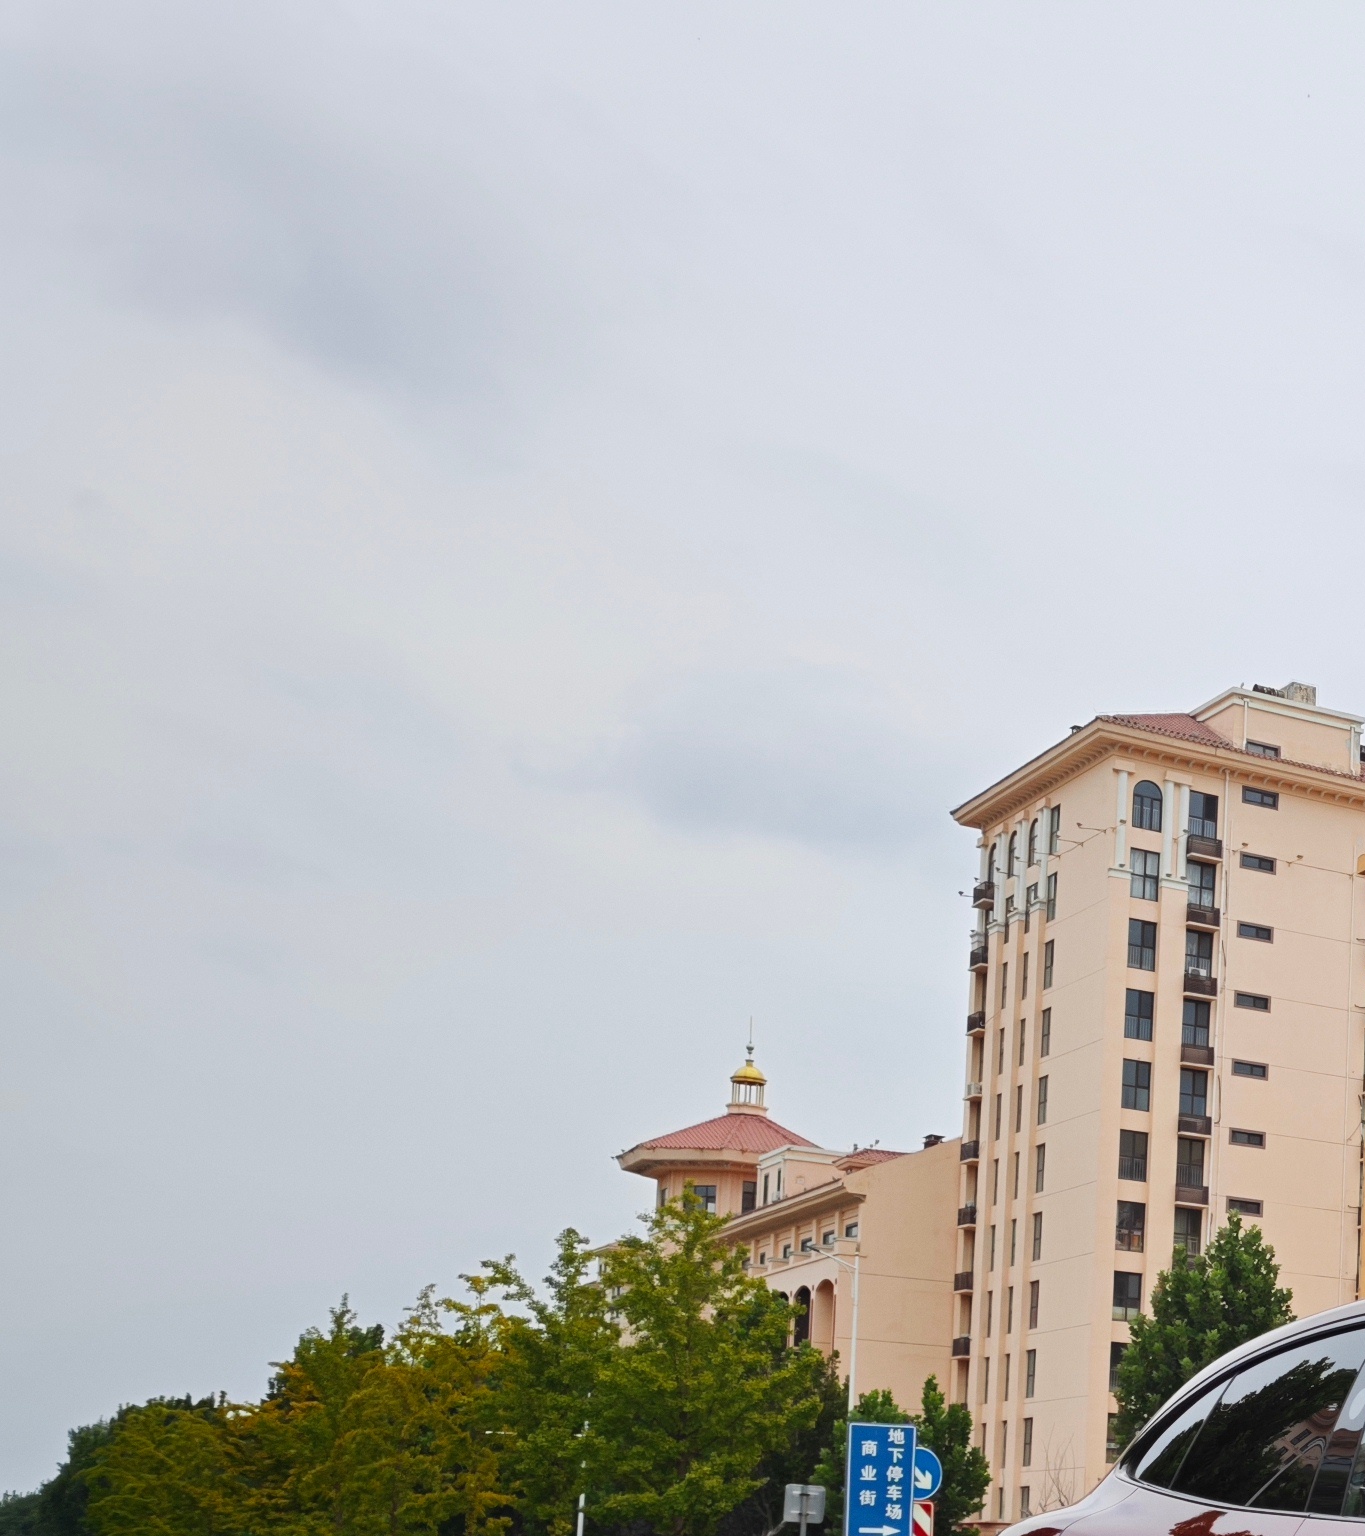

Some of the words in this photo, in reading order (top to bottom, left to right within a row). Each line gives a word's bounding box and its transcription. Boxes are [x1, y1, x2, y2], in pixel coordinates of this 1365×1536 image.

[859, 1440, 878, 1507] 商业街
[885, 1428, 905, 1520] 地下停车场
